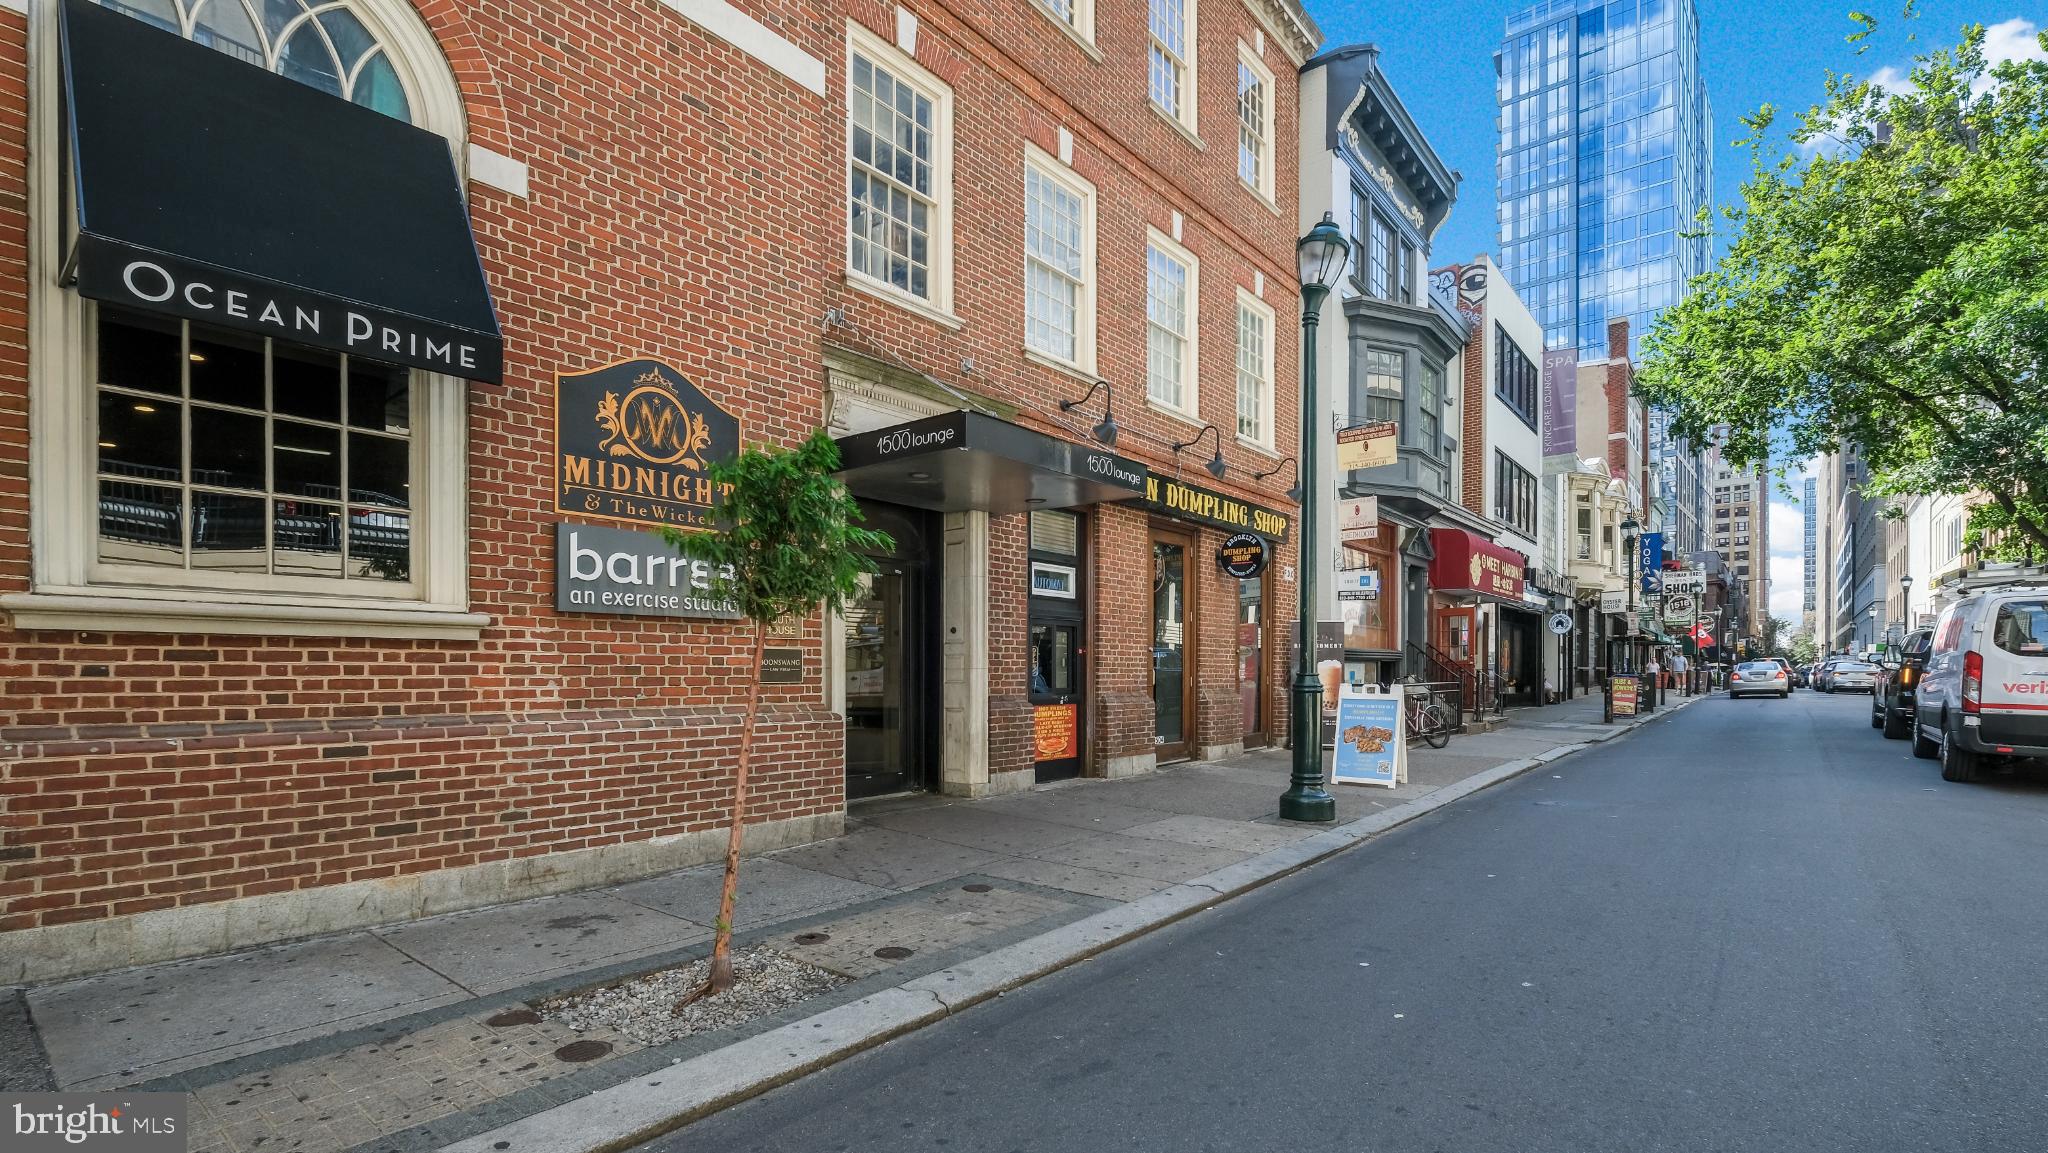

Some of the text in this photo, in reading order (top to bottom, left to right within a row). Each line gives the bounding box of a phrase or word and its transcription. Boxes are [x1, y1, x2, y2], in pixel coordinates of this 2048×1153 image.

[122, 261, 477, 369] OCEAN PRIME
[1545, 355, 1574, 369] SPA
[1543, 370, 1552, 453] SKINCARE LOUNGE
[876, 427, 955, 455] 1500 lounge
[1086, 455, 1141, 485] 1500 lounge
[584, 493, 600, 511] &
[610, 498, 647, 517] The
[1166, 482, 1249, 527] DUMPLING
[1253, 509, 1287, 537] SHOP
[1223, 546, 1261, 557] DUMPLING
[1232, 554, 1252, 562] SHOP
[1643, 538, 1651, 575] YOGA
[1486, 555, 1500, 574] MEET
[570, 589, 595, 605] an
[601, 590, 679, 610] exercise
[1670, 599, 1690, 610] 1518
[769, 614, 796, 625] OUTH
